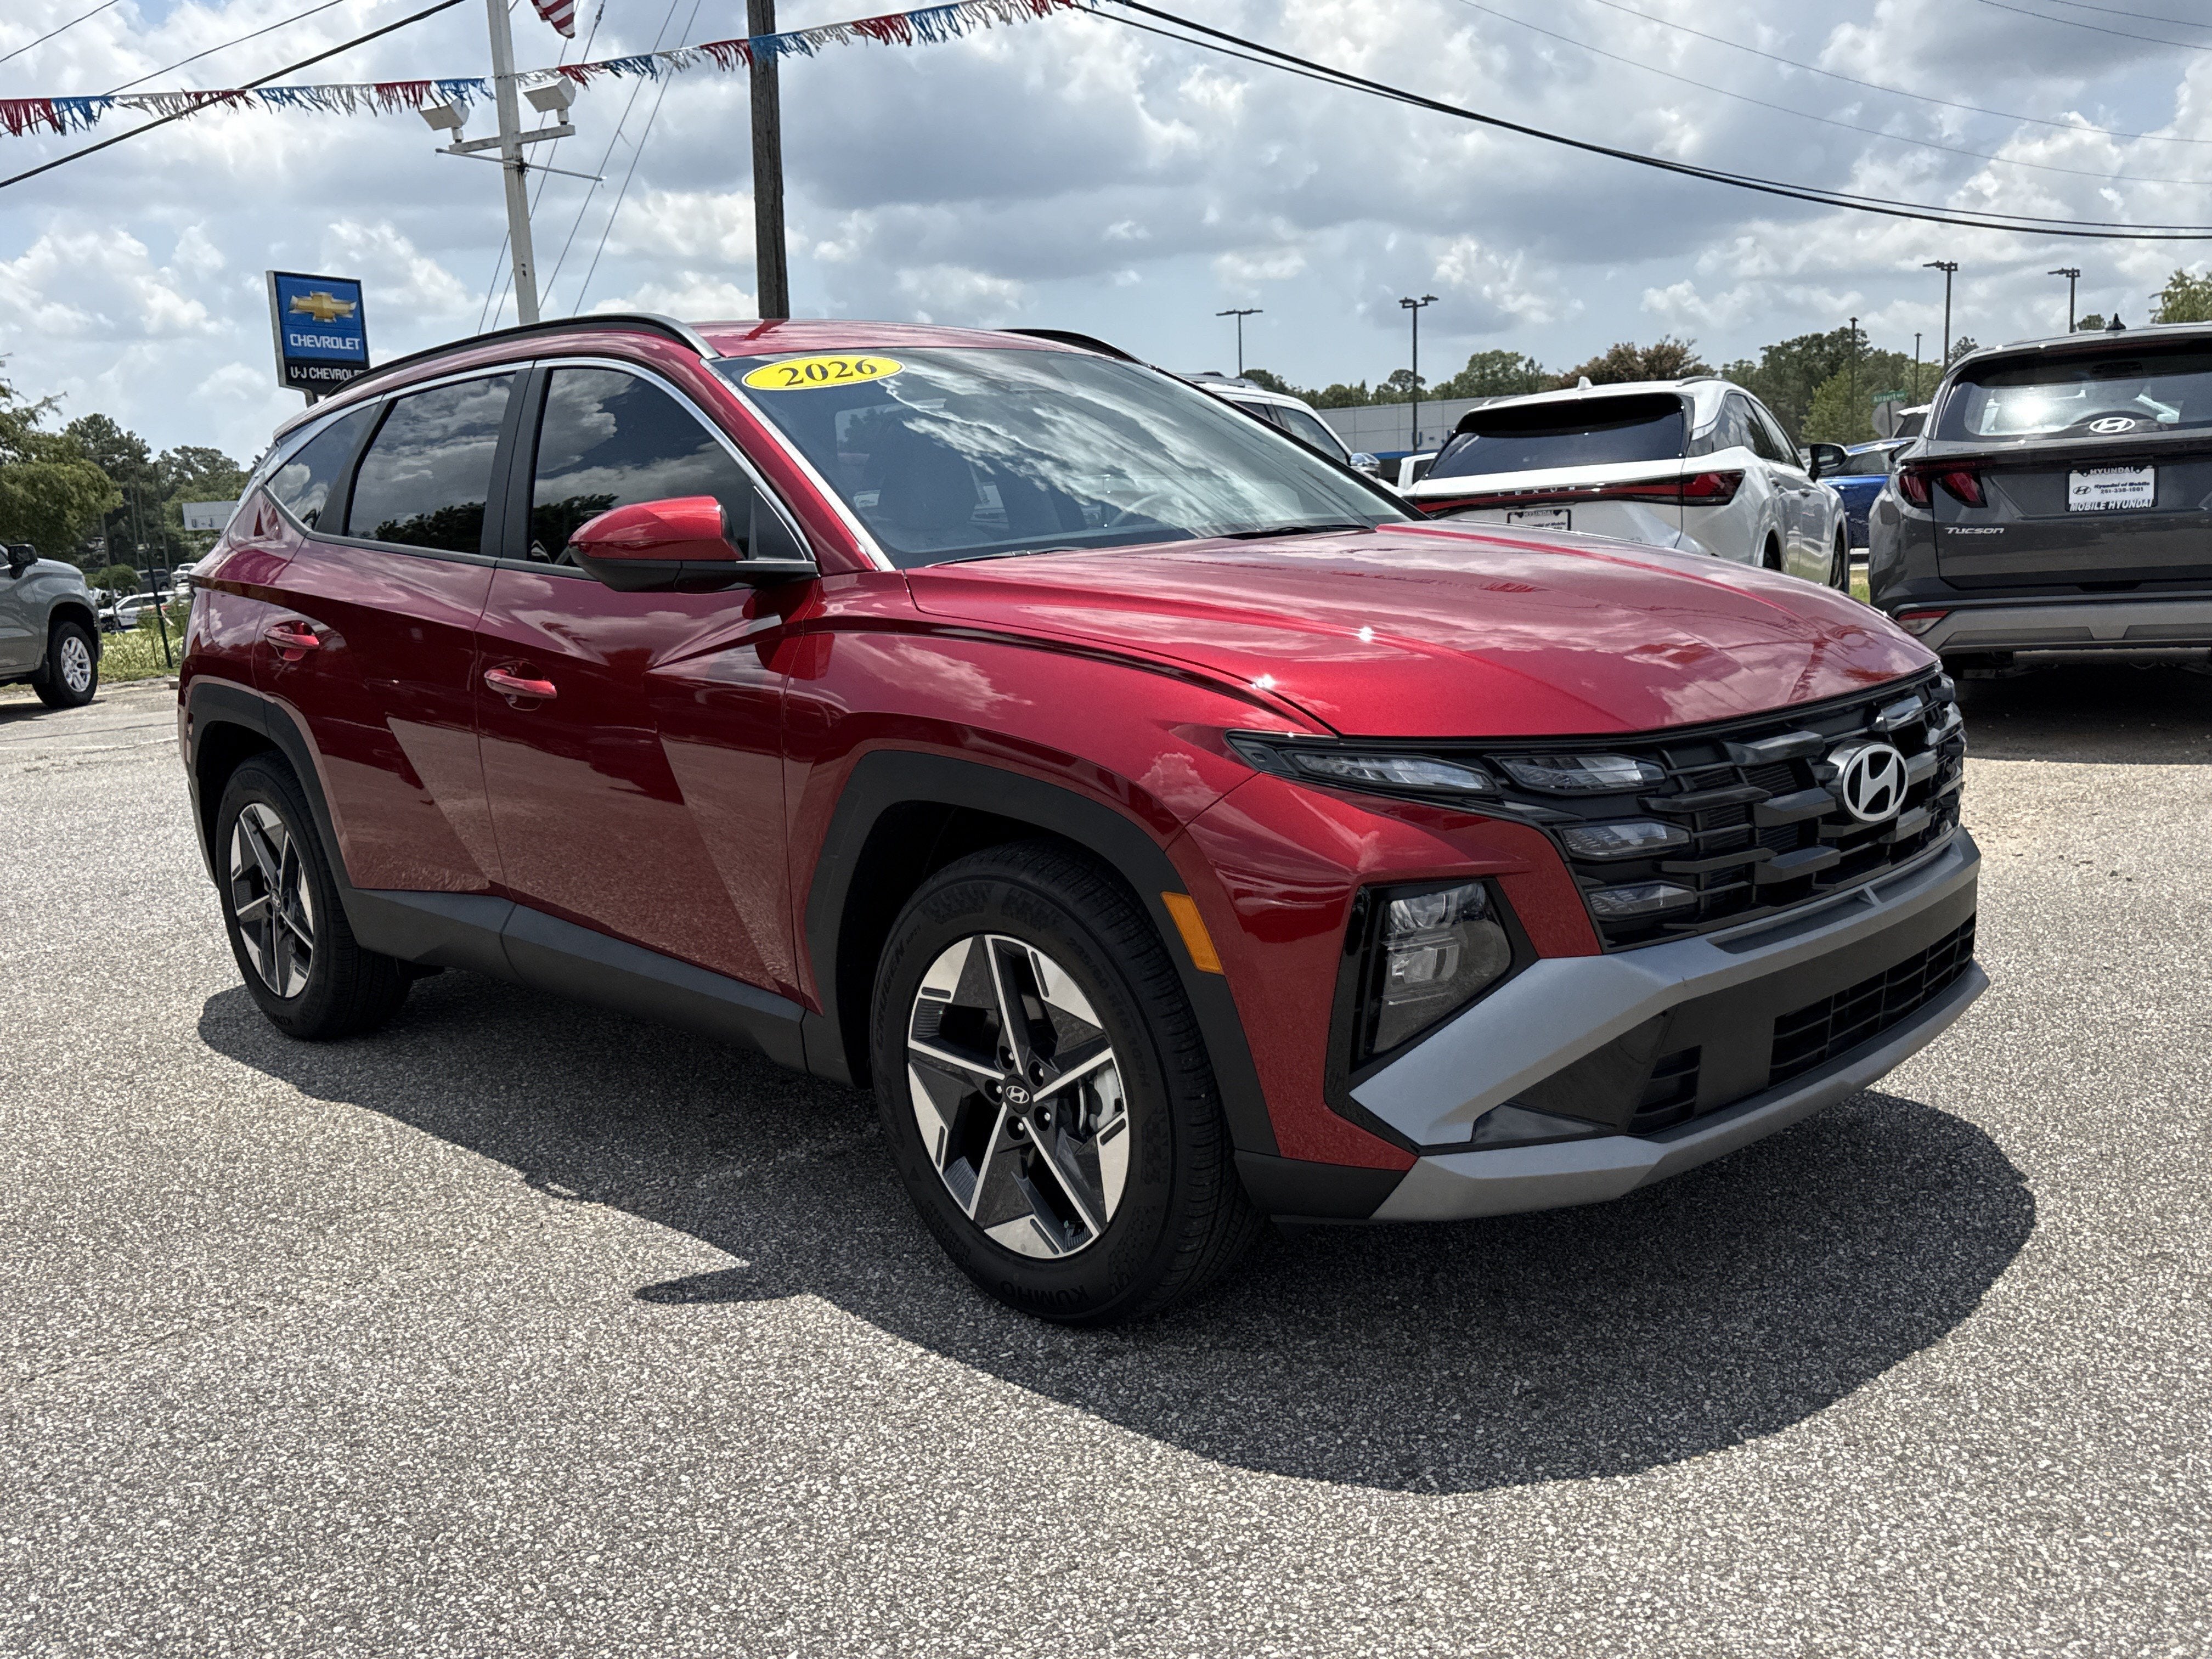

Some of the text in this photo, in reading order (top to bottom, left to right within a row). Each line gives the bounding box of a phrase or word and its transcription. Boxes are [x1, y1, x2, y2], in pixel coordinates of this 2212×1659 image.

[290, 334, 360, 350] CHEVROLET
[290, 366, 307, 379] U-J
[778, 358, 877, 386] 2026
[2090, 466, 2134, 476] HYUNDAI
[1498, 486, 1576, 497] LEXUS
[2069, 499, 2153, 512] MOBILE HYUNDAI
[191, 518, 213, 528] U-J
[1000, 1280, 1091, 1307] KUMHO
